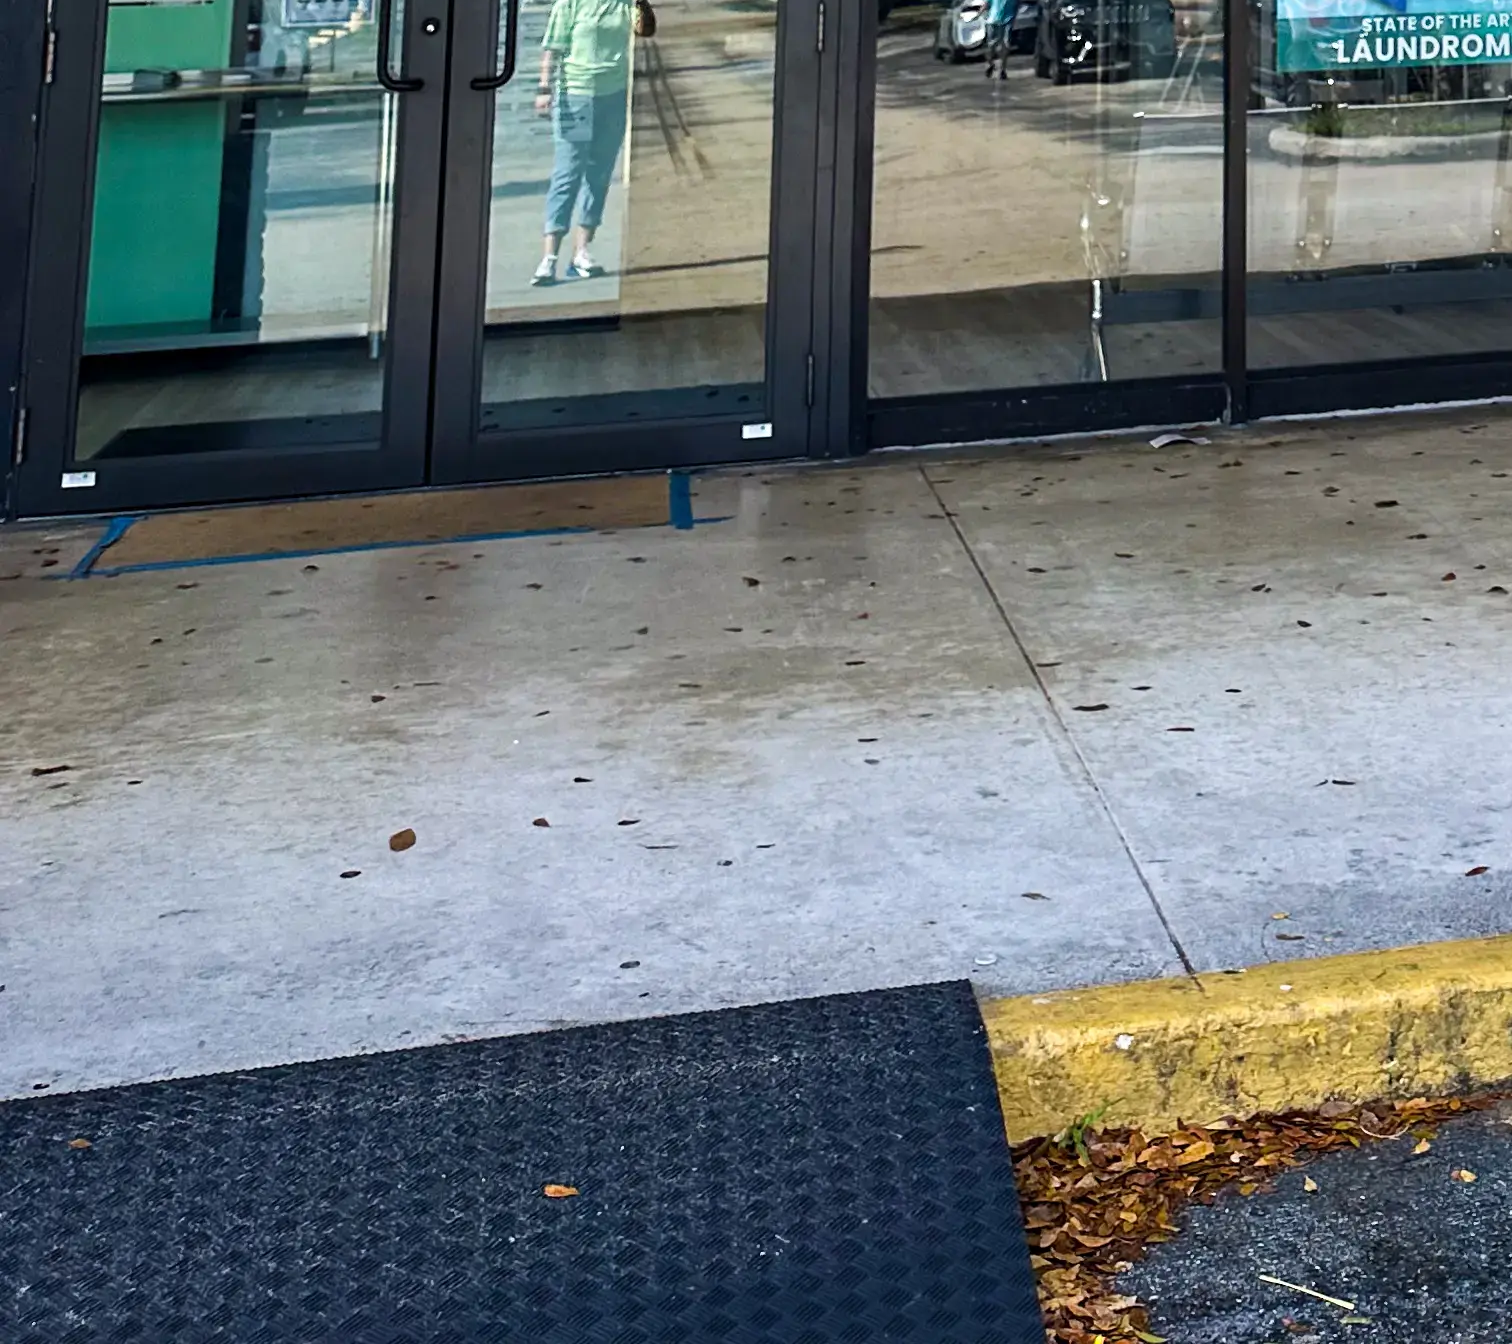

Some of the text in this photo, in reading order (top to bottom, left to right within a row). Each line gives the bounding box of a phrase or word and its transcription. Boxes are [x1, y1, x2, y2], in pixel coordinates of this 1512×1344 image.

[1361, 15, 1418, 34] STATE
[1421, 14, 1446, 32] OF
[1449, 13, 1483, 31] THE
